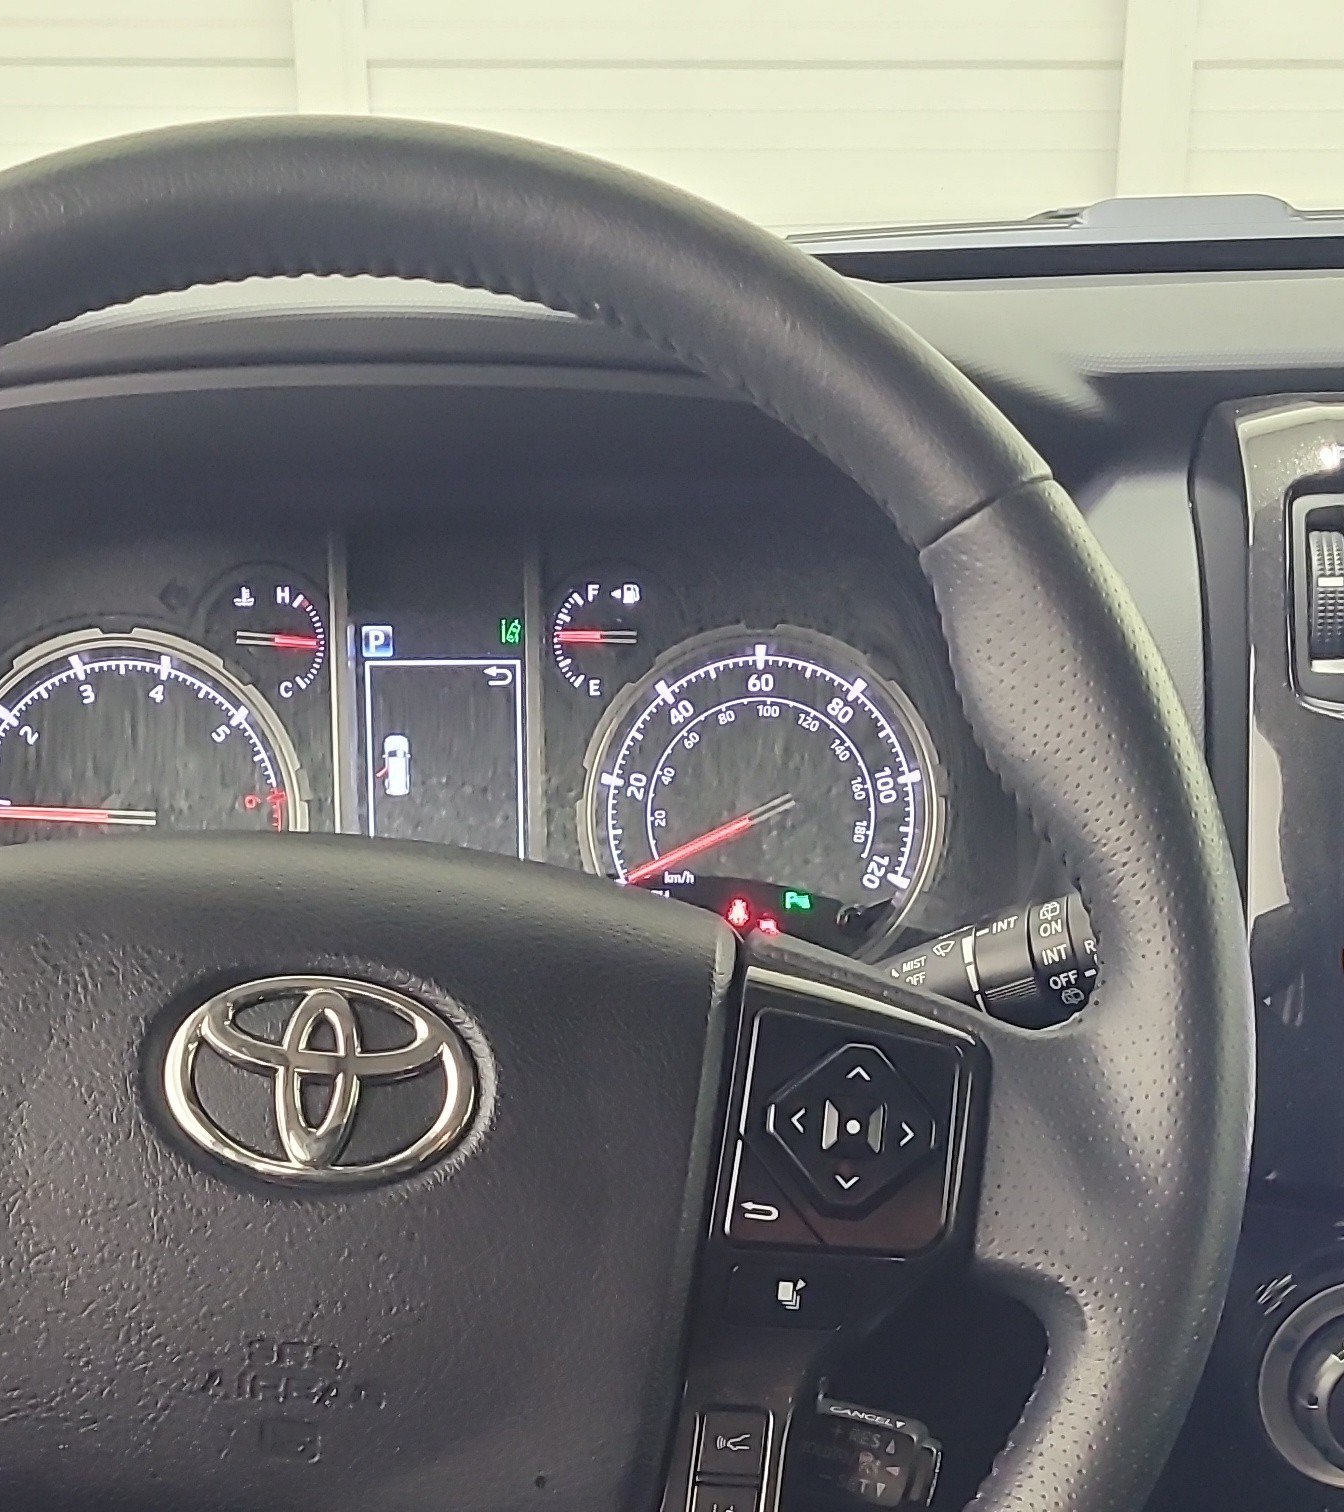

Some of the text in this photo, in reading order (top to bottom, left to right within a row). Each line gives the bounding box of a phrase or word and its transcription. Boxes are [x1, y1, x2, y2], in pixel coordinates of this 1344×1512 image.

[277, 586, 290, 604] H
[588, 584, 599, 602] F
[279, 681, 294, 699] C
[588, 679, 601, 697] E
[748, 674, 774, 692] 60
[79, 684, 96, 705] 3
[148, 684, 165, 704] 4
[669, 700, 695, 726] 40
[718, 710, 735, 726] 80
[756, 705, 780, 718] 100
[826, 697, 854, 724] 80
[797, 713, 820, 732] 120
[19, 725, 40, 746] 2
[211, 725, 231, 744] 5
[682, 732, 700, 750] 60
[829, 738, 850, 762] 140
[660, 767, 676, 786] 40
[875, 766, 897, 804] 100
[626, 773, 647, 801] 20
[850, 776, 866, 801] 160
[654, 810, 667, 827] 20
[852, 819, 868, 843] 180
[664, 871, 695, 884] km/h
[862, 853, 890, 890] 120
[992, 916, 1018, 934] INT
[1040, 919, 1063, 938] ON
[902, 955, 927, 973] MIST
[1042, 943, 1067, 966] INT
[1049, 970, 1078, 990] OFF
[829, 1406, 894, 1427] CANCEL
